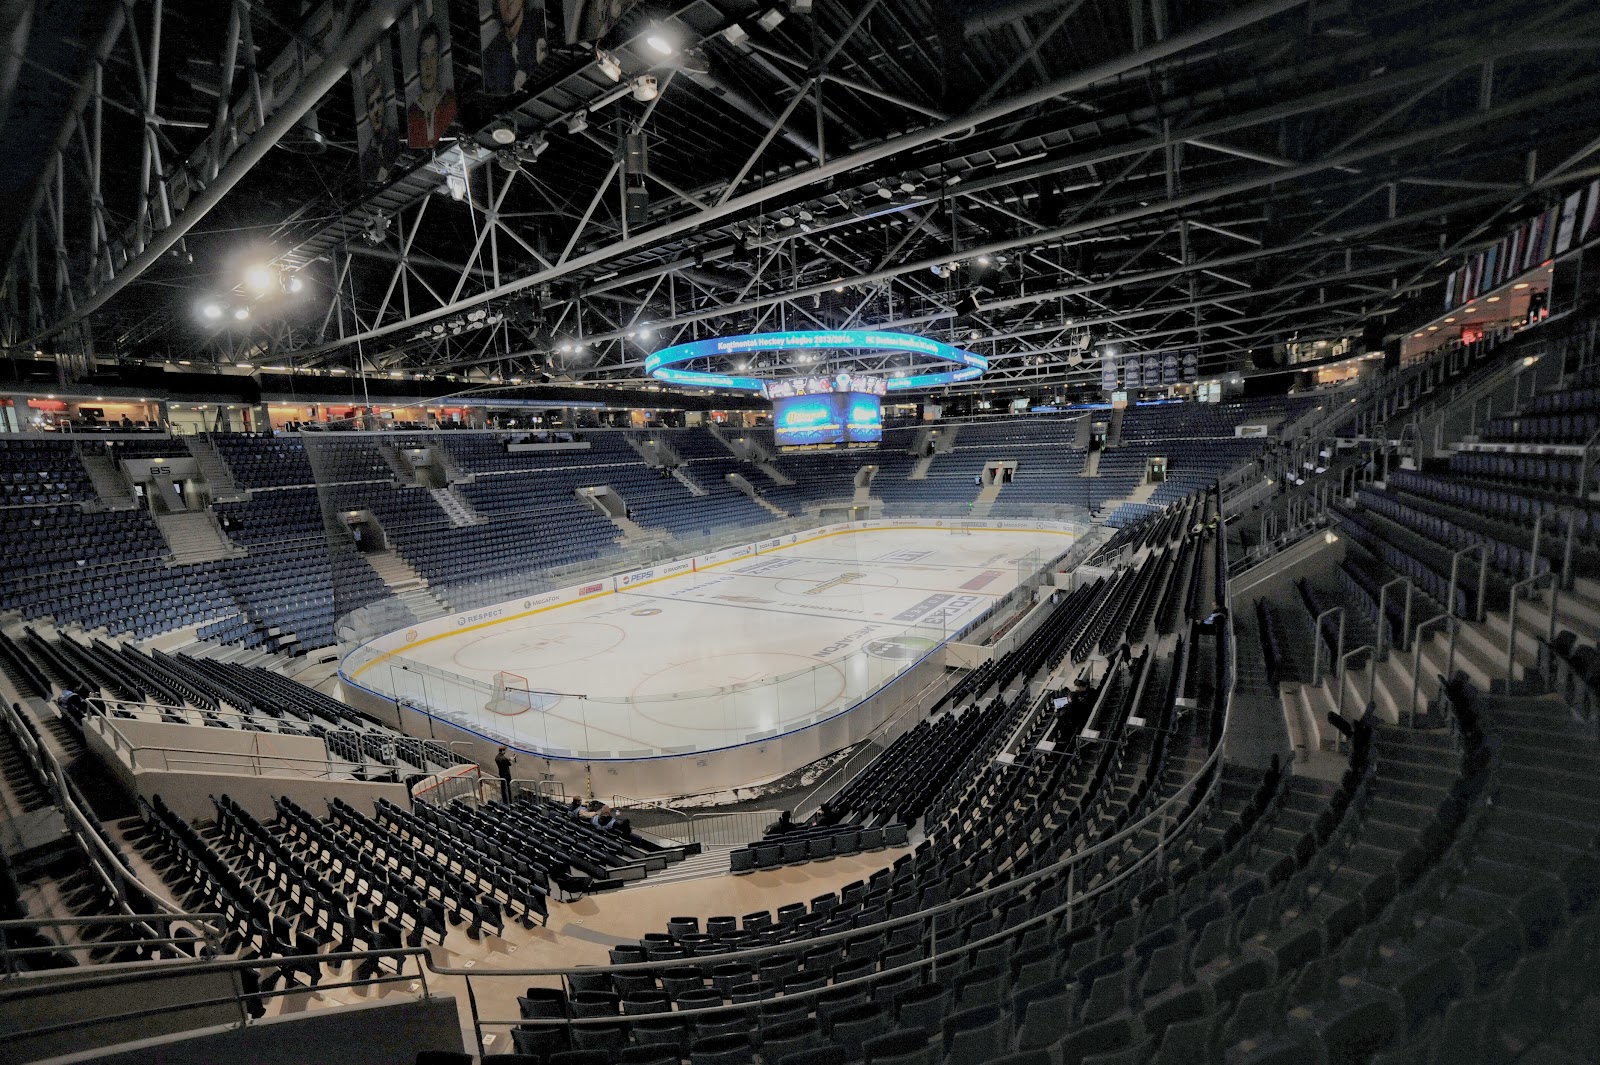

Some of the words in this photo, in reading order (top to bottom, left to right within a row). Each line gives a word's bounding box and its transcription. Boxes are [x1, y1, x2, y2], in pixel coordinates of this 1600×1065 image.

[759, 338, 785, 346] Hockey
[630, 570, 654, 582] PEPSI
[468, 609, 502, 622] RESPECT
